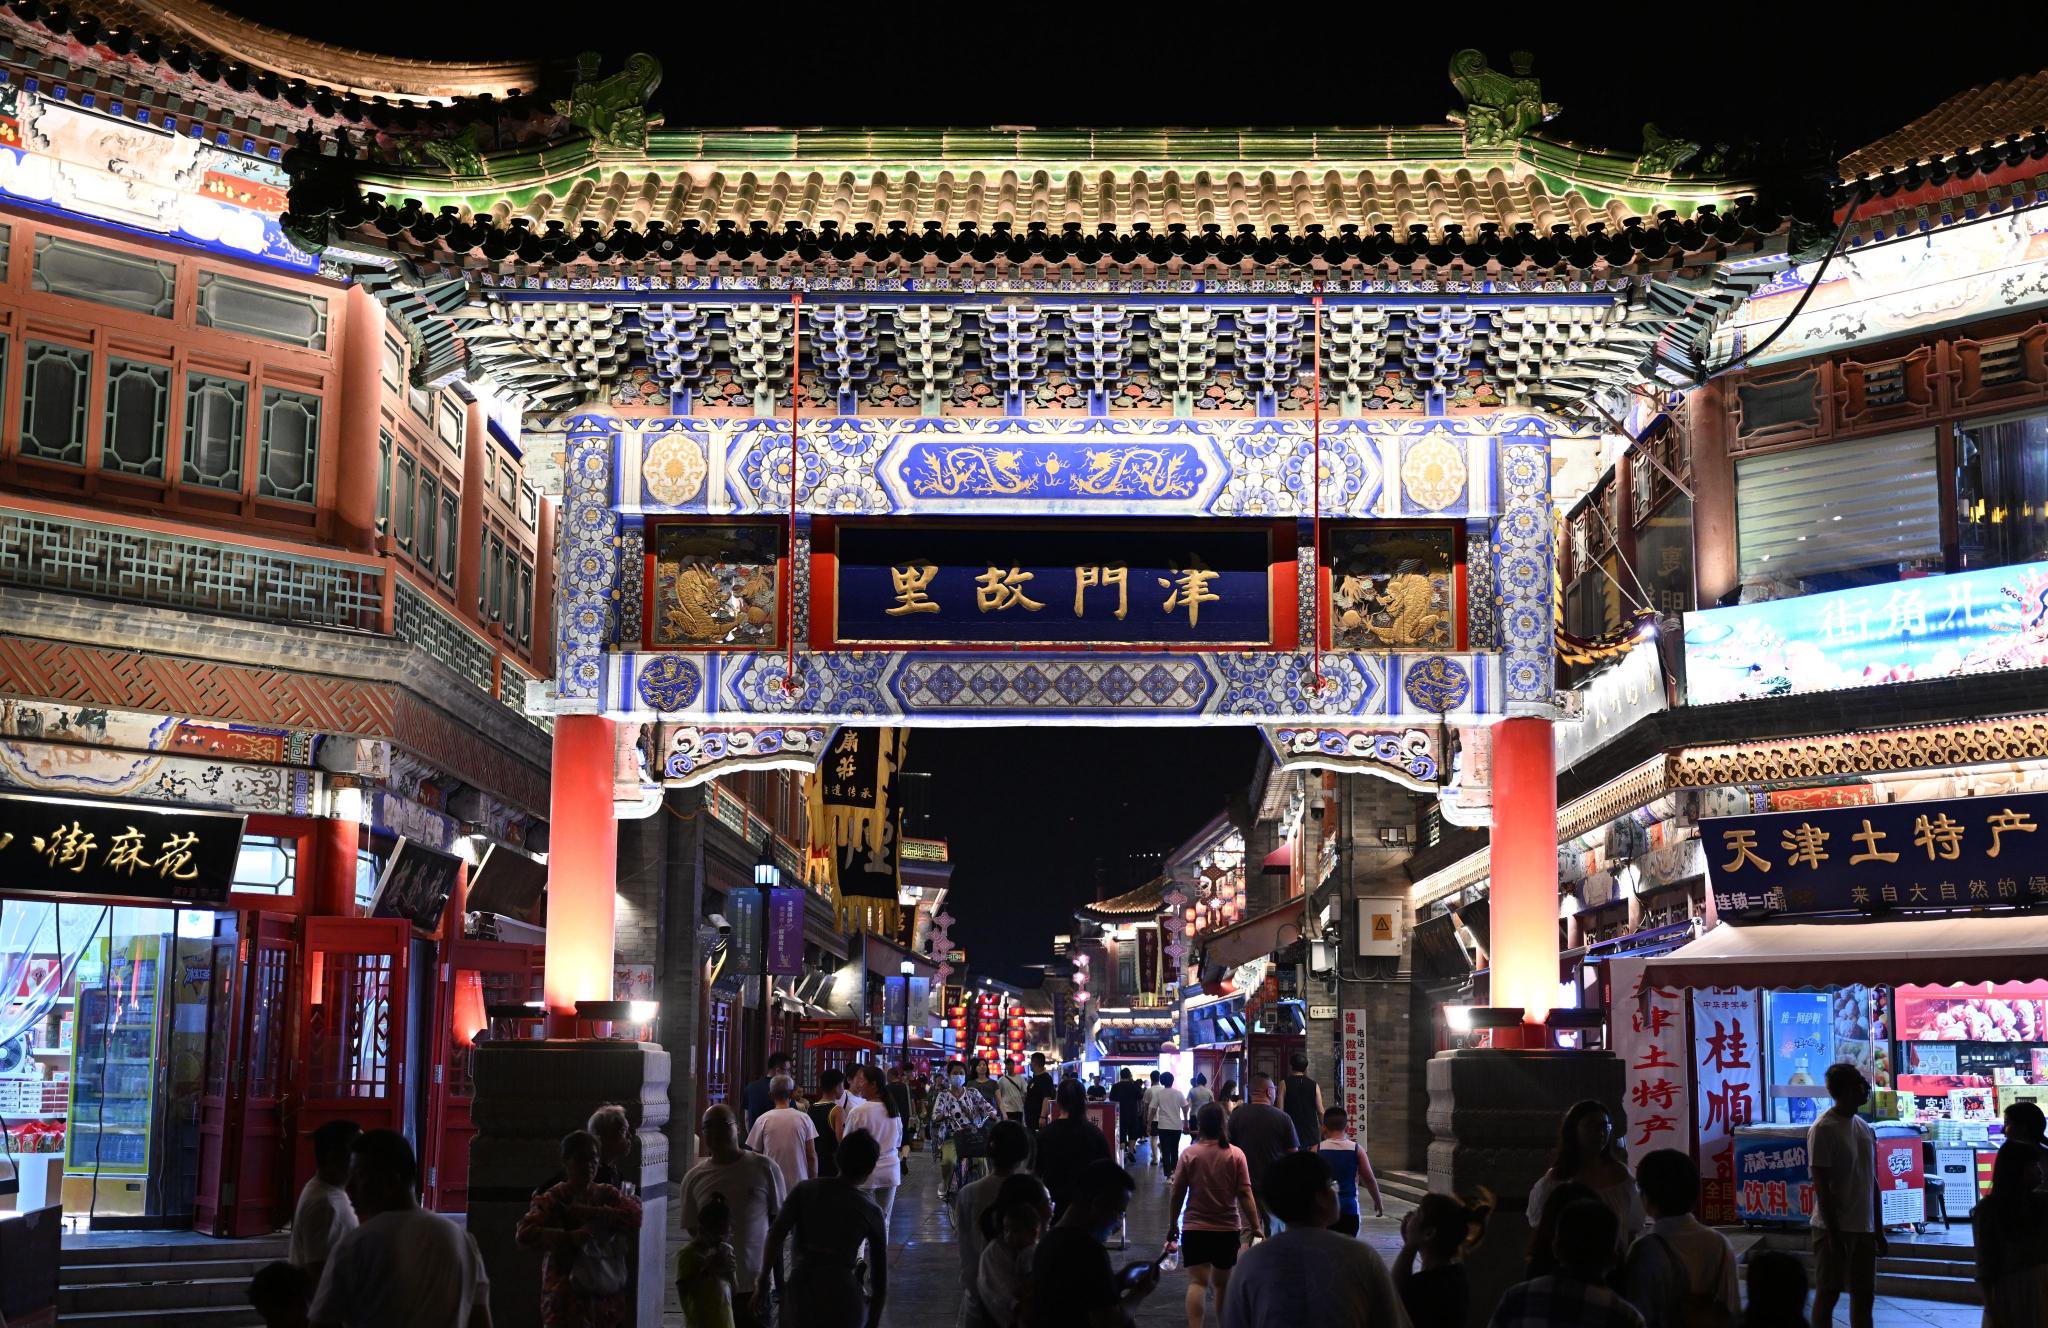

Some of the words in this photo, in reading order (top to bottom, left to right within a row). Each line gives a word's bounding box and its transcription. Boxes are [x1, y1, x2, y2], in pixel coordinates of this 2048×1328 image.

[1721, 808, 2038, 873] 天津土特产
[1715, 890, 1779, 911] 连锁二店
[1357, 1029, 1367, 1048] 电话
[1358, 1053, 1366, 1132] 27344949
[1345, 1092, 1358, 1143] 装裱十字
[1743, 1179, 1789, 1217] 饮料
